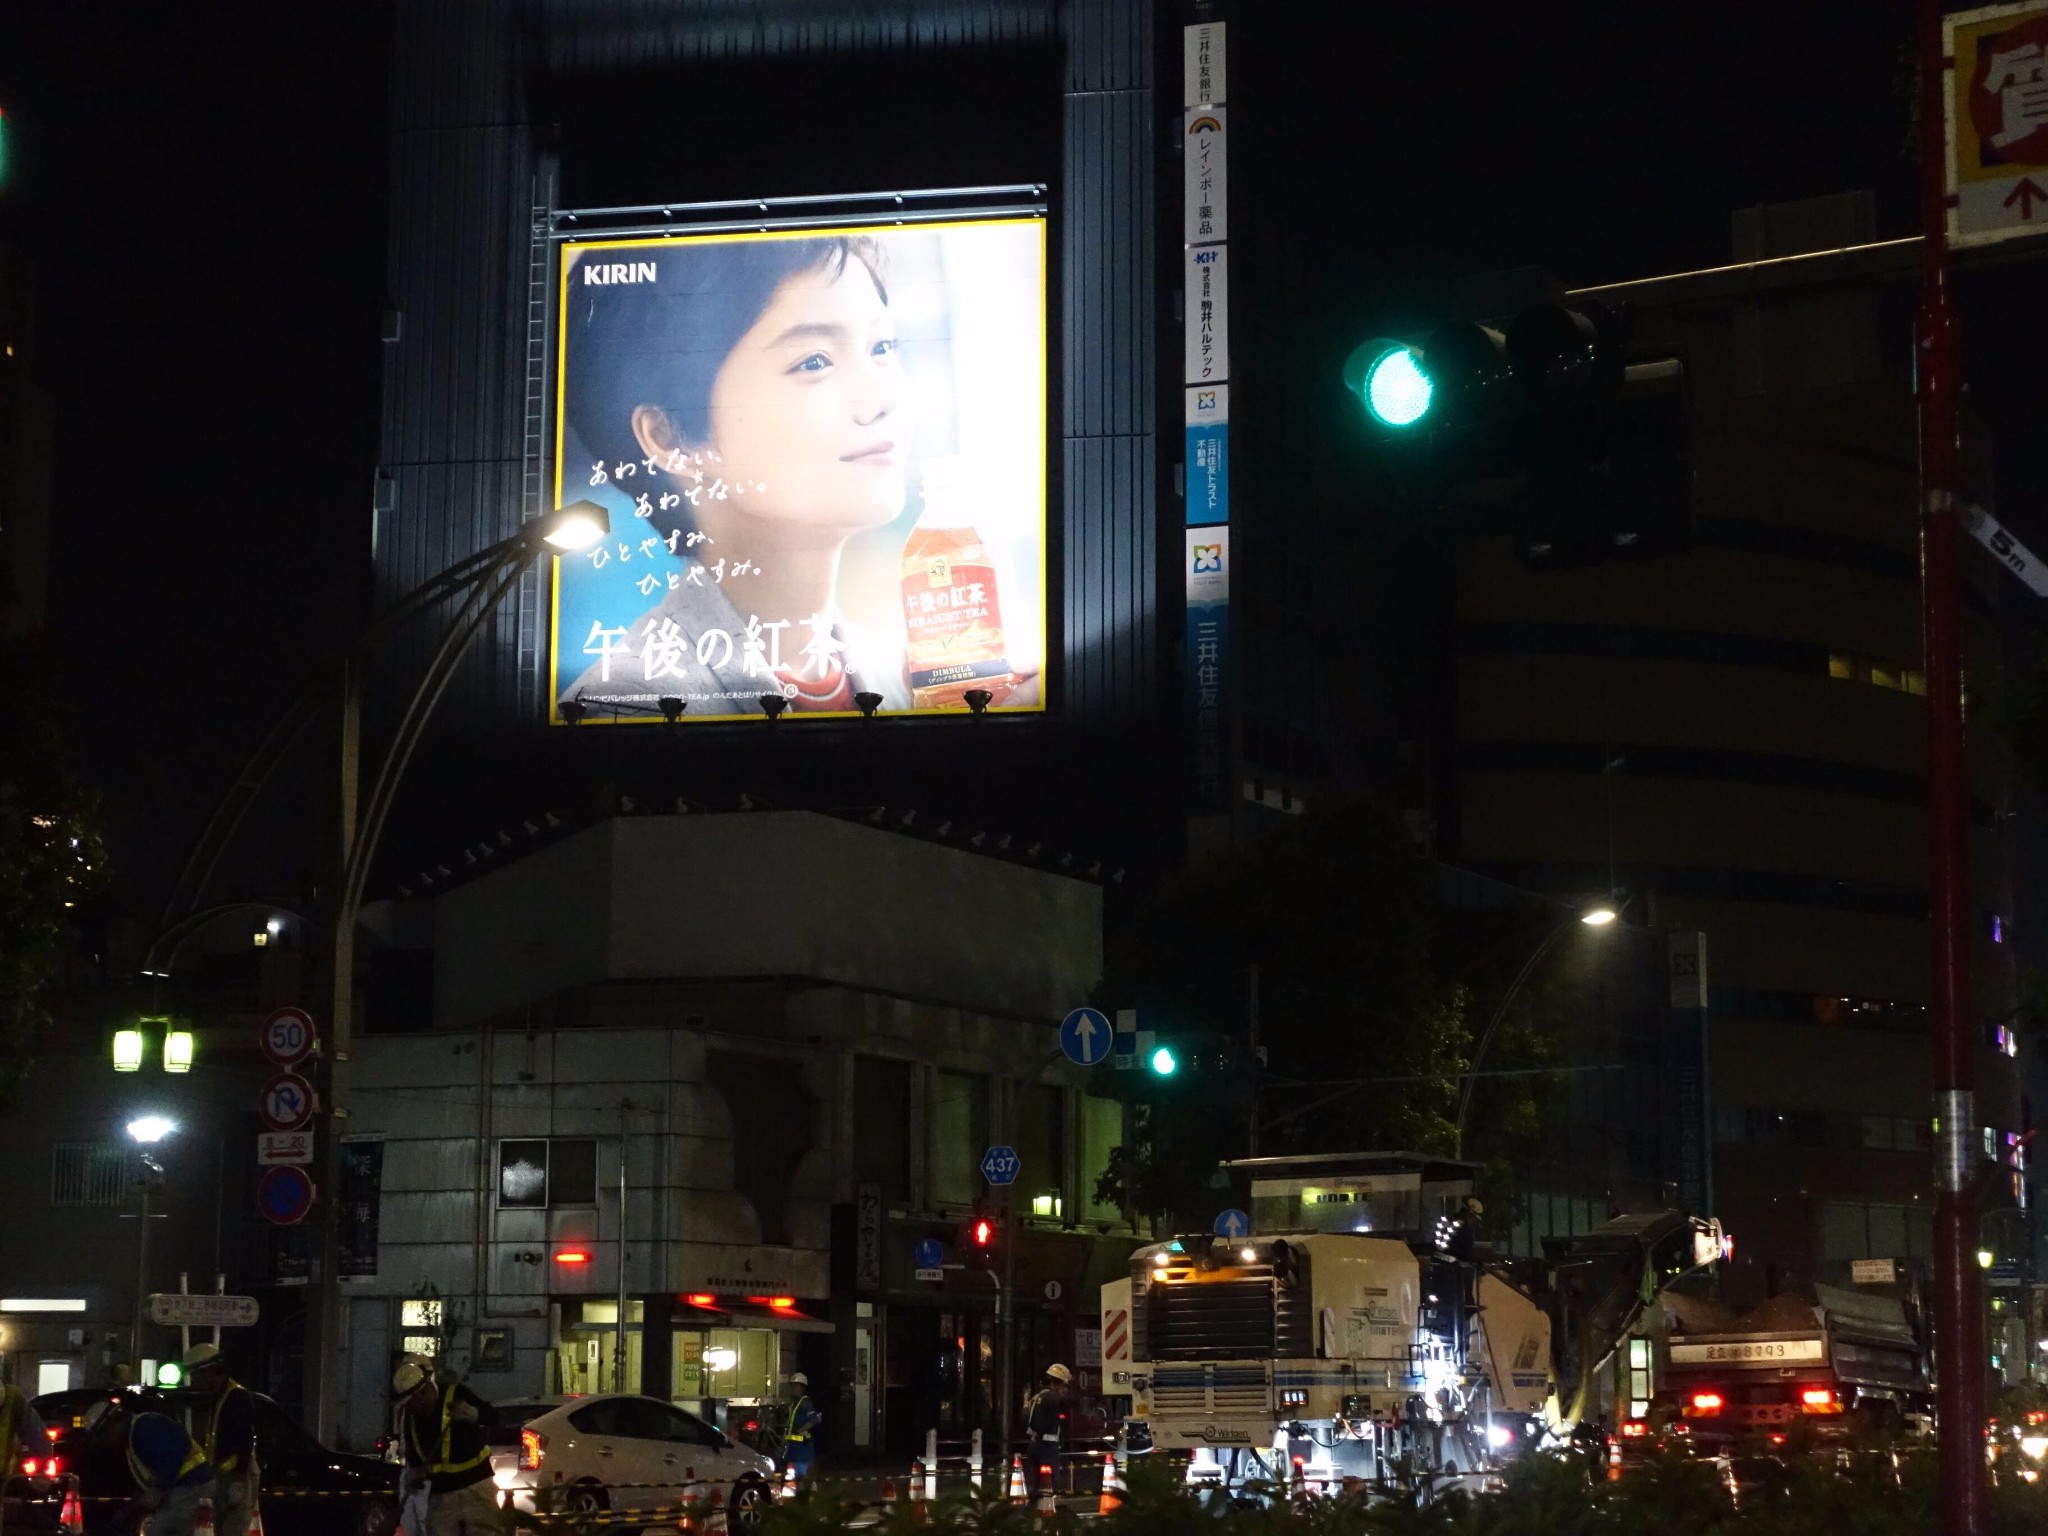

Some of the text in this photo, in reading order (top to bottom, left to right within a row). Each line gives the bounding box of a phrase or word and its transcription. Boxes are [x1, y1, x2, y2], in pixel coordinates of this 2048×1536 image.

[1199, 27, 1211, 102] 三井住友銀行
[1199, 138, 1213, 235] レインボー薬品
[584, 262, 657, 285] KIRIN
[1201, 299, 1212, 378] 駒井ハルテック
[1196, 439, 1206, 467] 不動産
[1207, 438, 1218, 509] 三井住友トラスト
[634, 478, 767, 518] あわてない。
[1989, 528, 2026, 572] 5m
[635, 558, 762, 596] ひとやすみ。
[908, 605, 989, 629] STRAIGHT TEA
[932, 664, 972, 677] DIMBULA
[273, 1024, 303, 1049] 50
[985, 1157, 1015, 1173] 437
